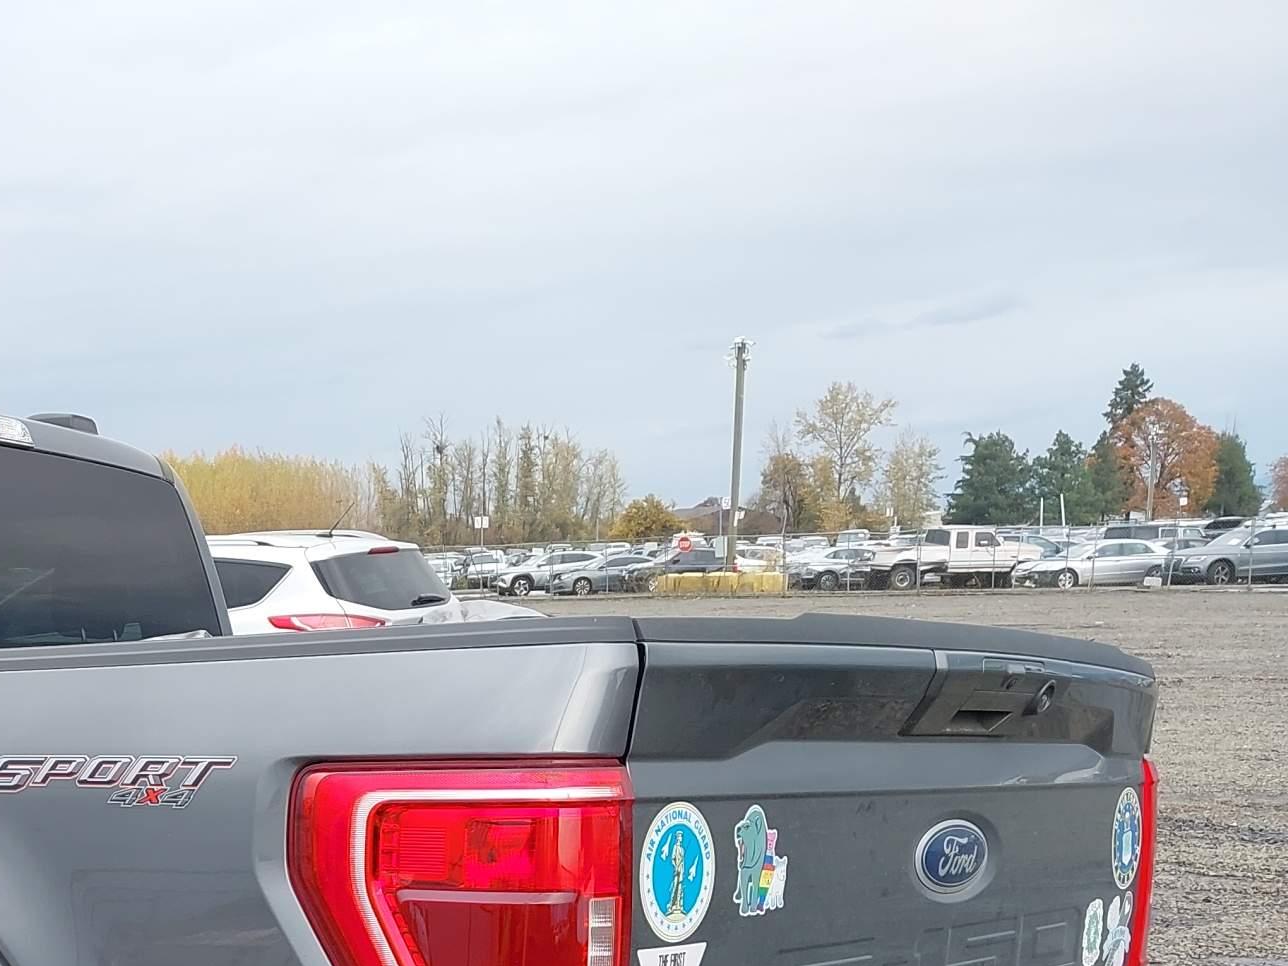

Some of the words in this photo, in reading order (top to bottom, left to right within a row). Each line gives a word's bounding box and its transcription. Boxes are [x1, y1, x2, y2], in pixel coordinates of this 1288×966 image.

[646, 839, 656, 862] AIR
[654, 809, 693, 836] NATIONAL
[694, 820, 711, 860] GUARD
[938, 835, 978, 877] Ford
